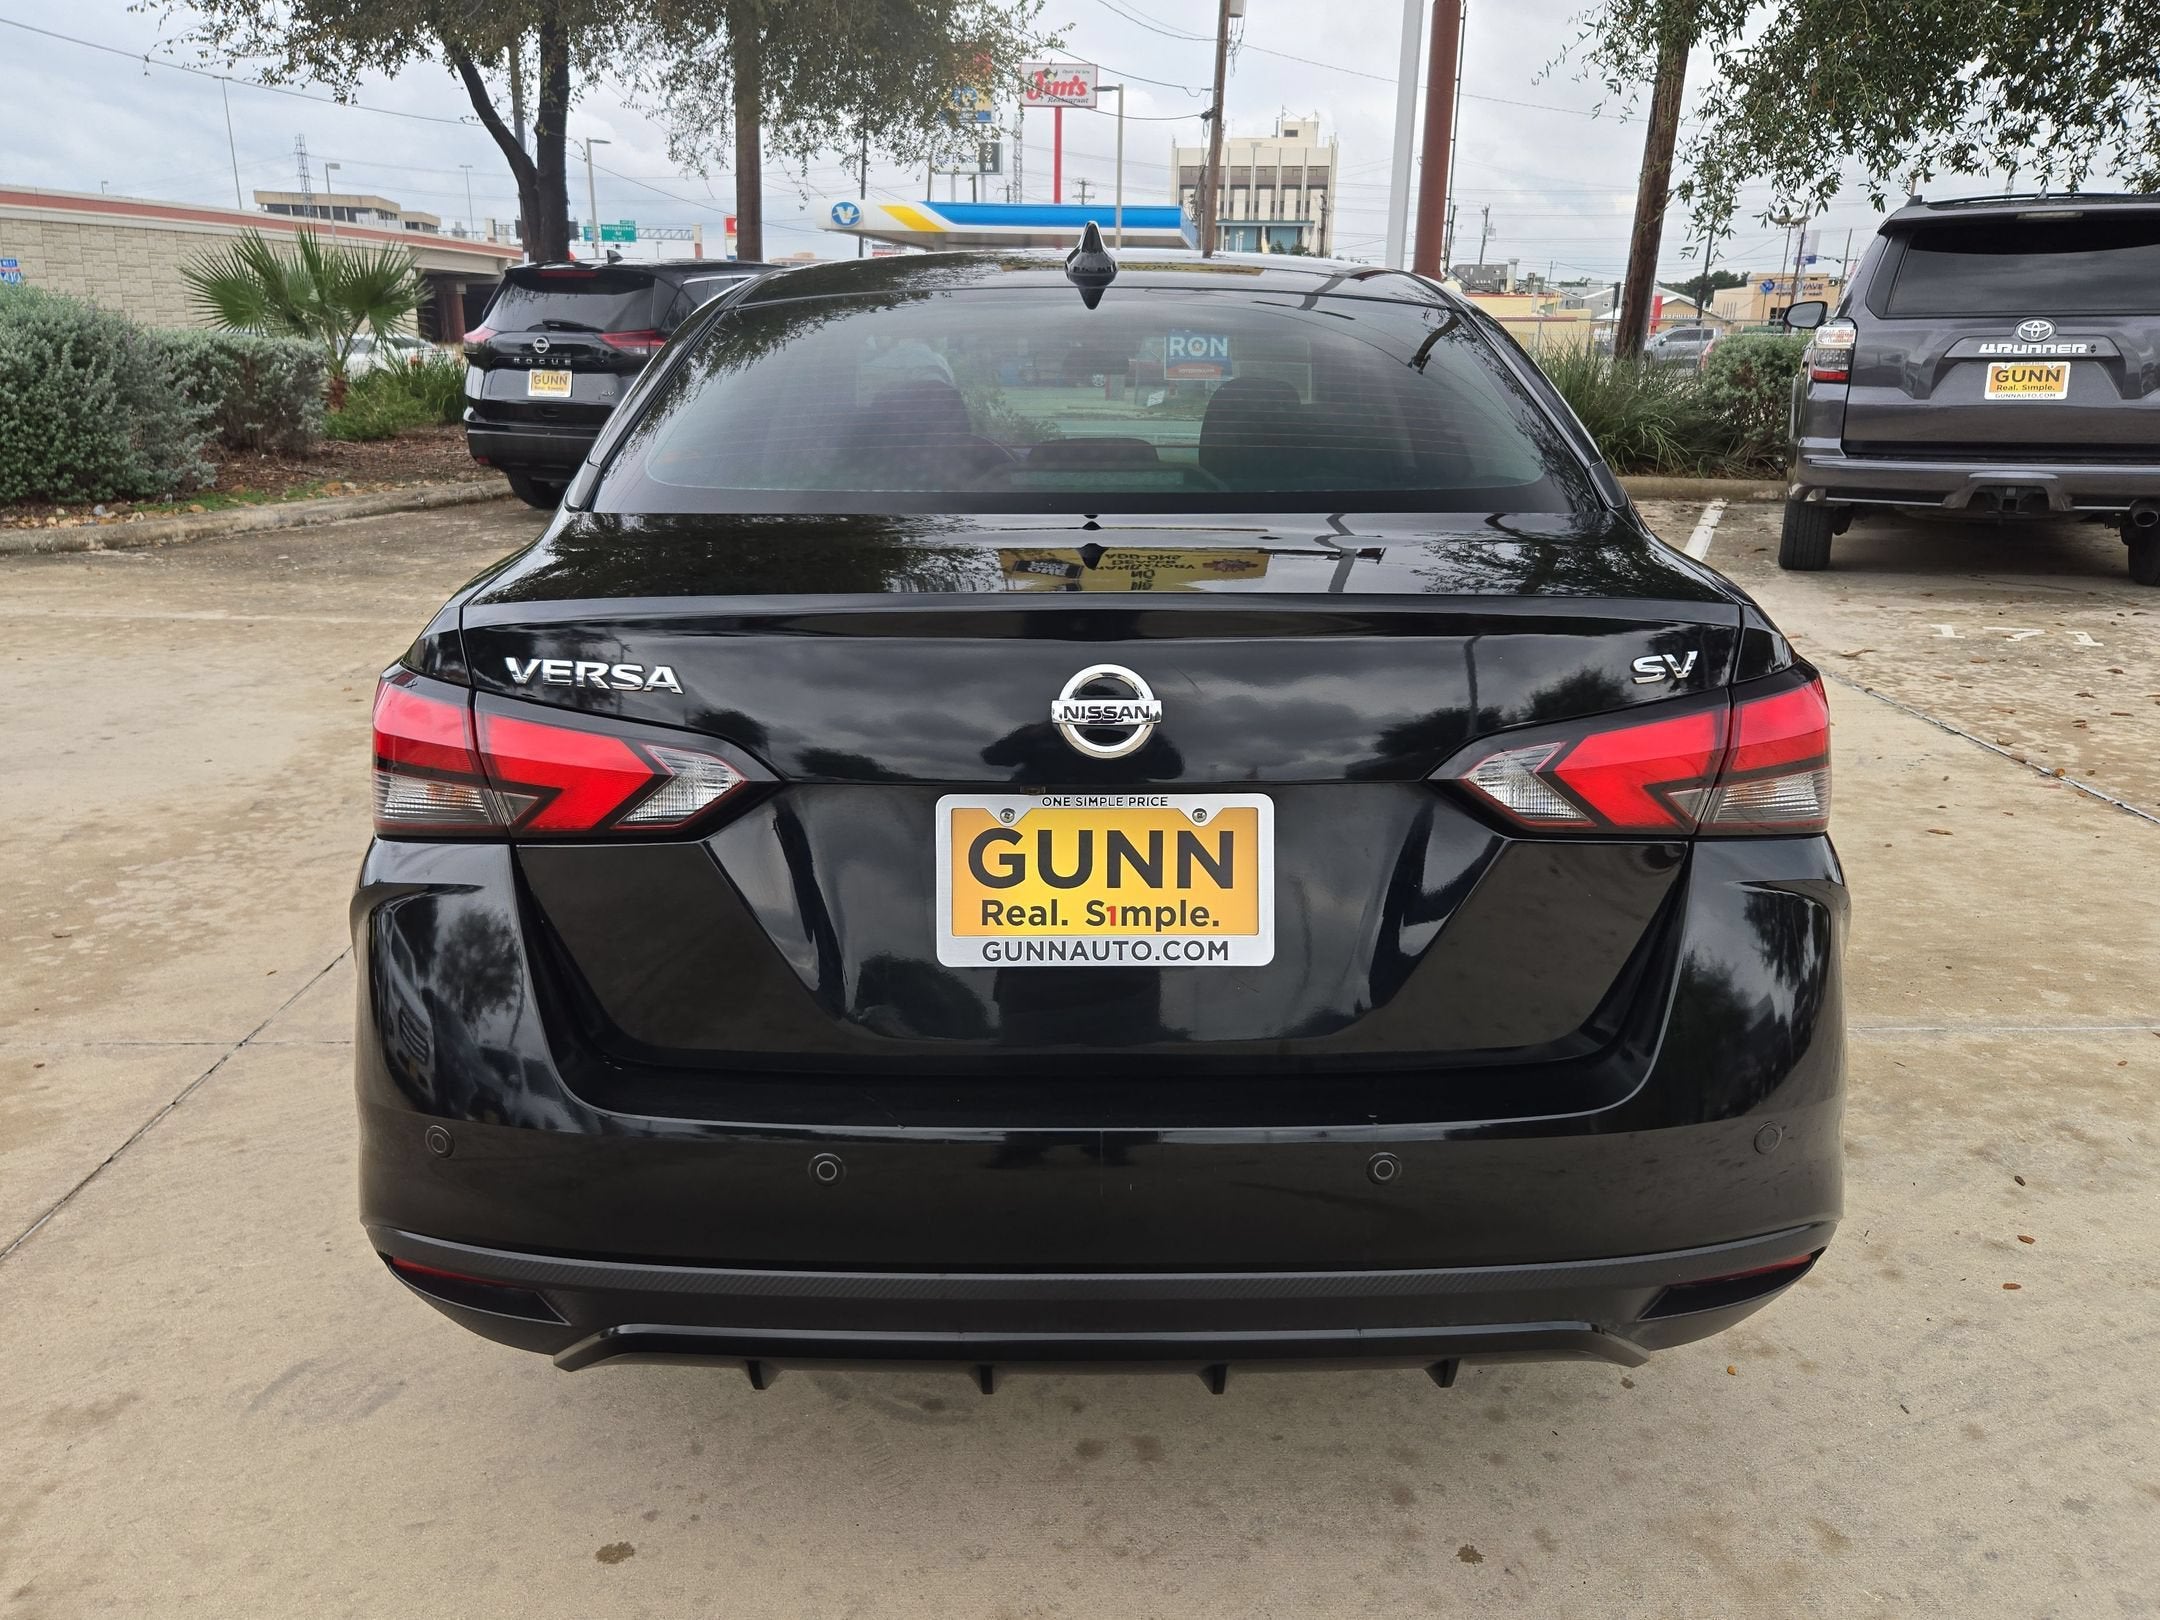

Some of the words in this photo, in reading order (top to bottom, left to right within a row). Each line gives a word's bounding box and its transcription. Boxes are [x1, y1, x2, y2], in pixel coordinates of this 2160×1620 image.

[1169, 336, 1228, 357] RON
[1978, 343, 2088, 354] 4RUNNER
[513, 357, 572, 366] ROGUE
[533, 374, 568, 385] GUNN
[1995, 369, 2061, 382] GUNN
[504, 656, 684, 695] VERSA
[1632, 650, 1698, 685] SV
[1063, 705, 1150, 720] NISSAN
[1041, 796, 1072, 807] ONE
[1075, 796, 1124, 807] SIMPLE
[1128, 796, 1169, 807] PRICE
[968, 827, 1235, 889] GUNN
[981, 899, 1069, 927] Real.
[982, 940, 1229, 962] GUNNAUTO.COM
